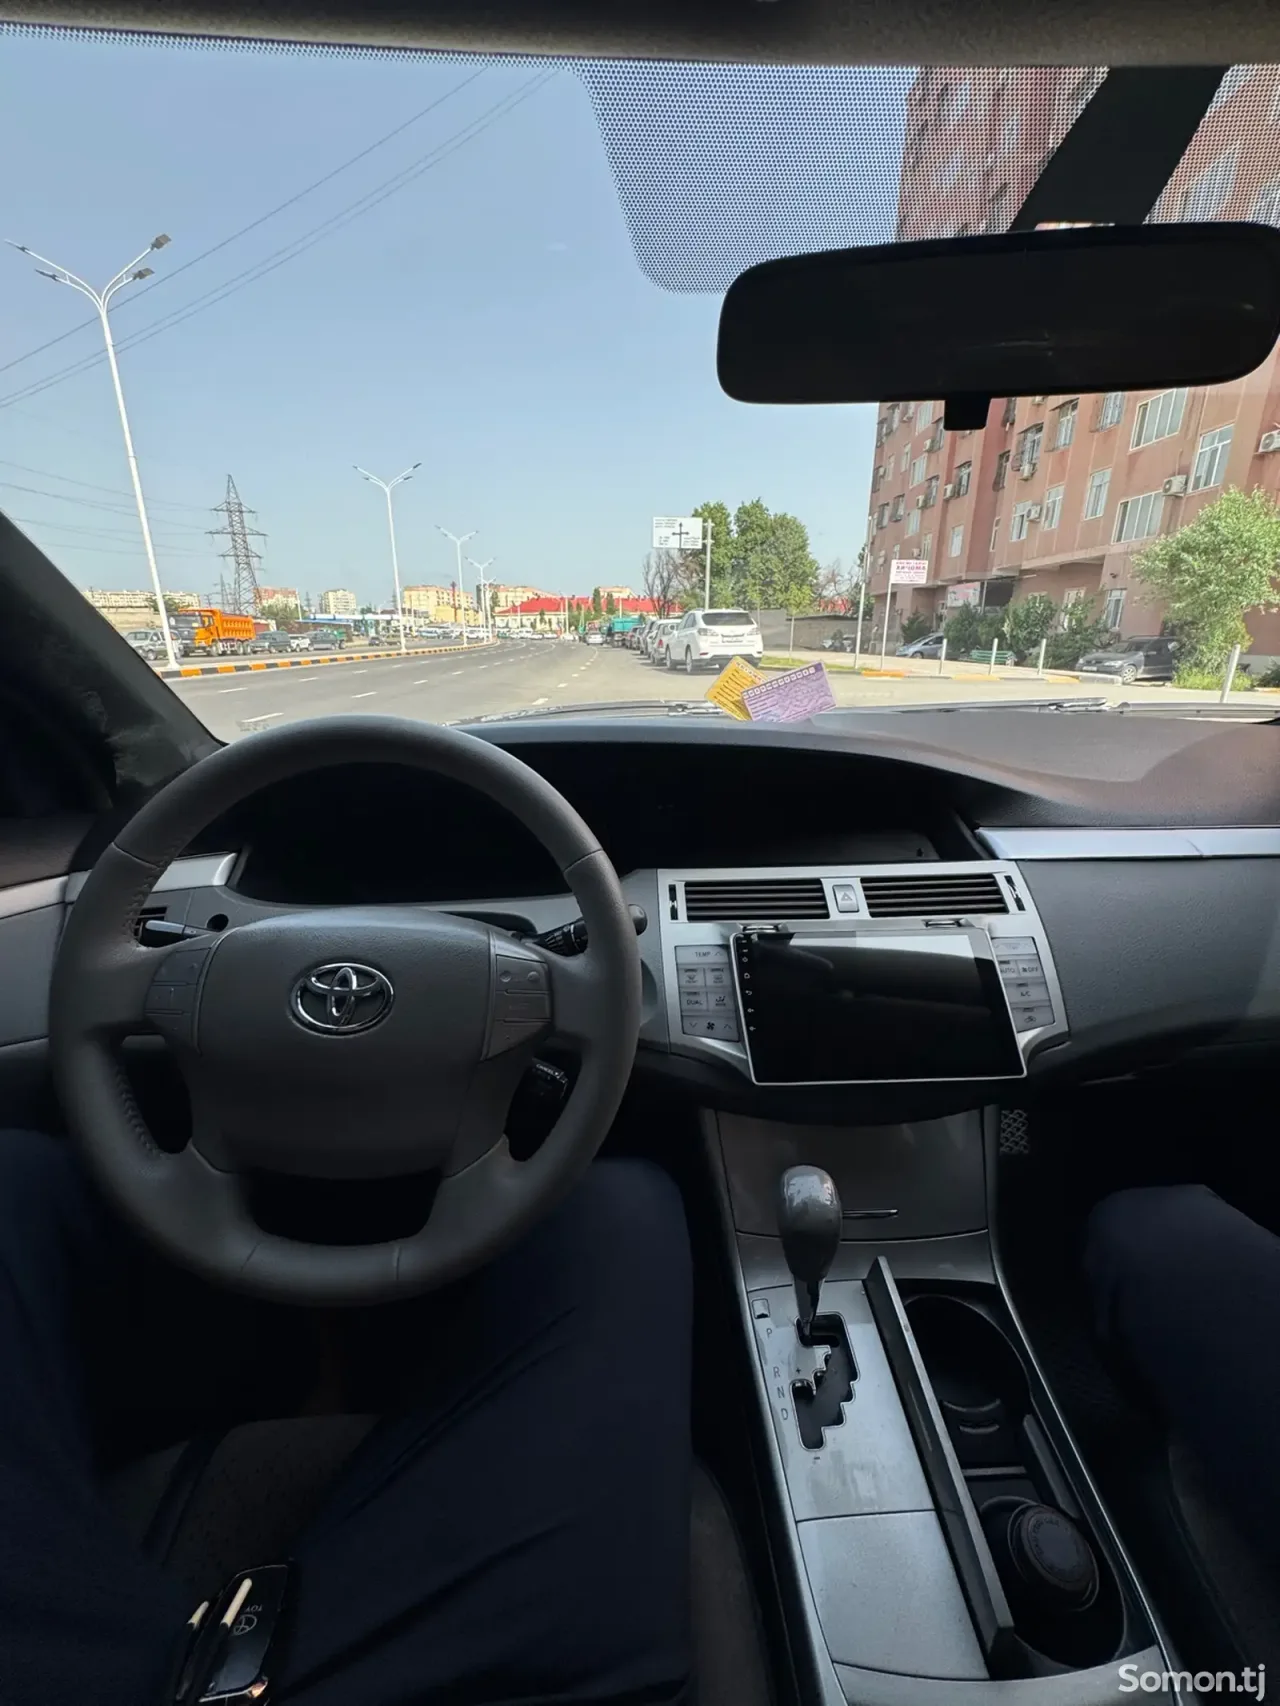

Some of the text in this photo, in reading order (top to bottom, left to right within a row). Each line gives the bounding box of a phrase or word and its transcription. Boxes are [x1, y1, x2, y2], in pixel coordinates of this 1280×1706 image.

[766, 1327, 773, 1339] P
[773, 1366, 781, 1379] R
[776, 1386, 786, 1399] N
[780, 1407, 789, 1421] D
